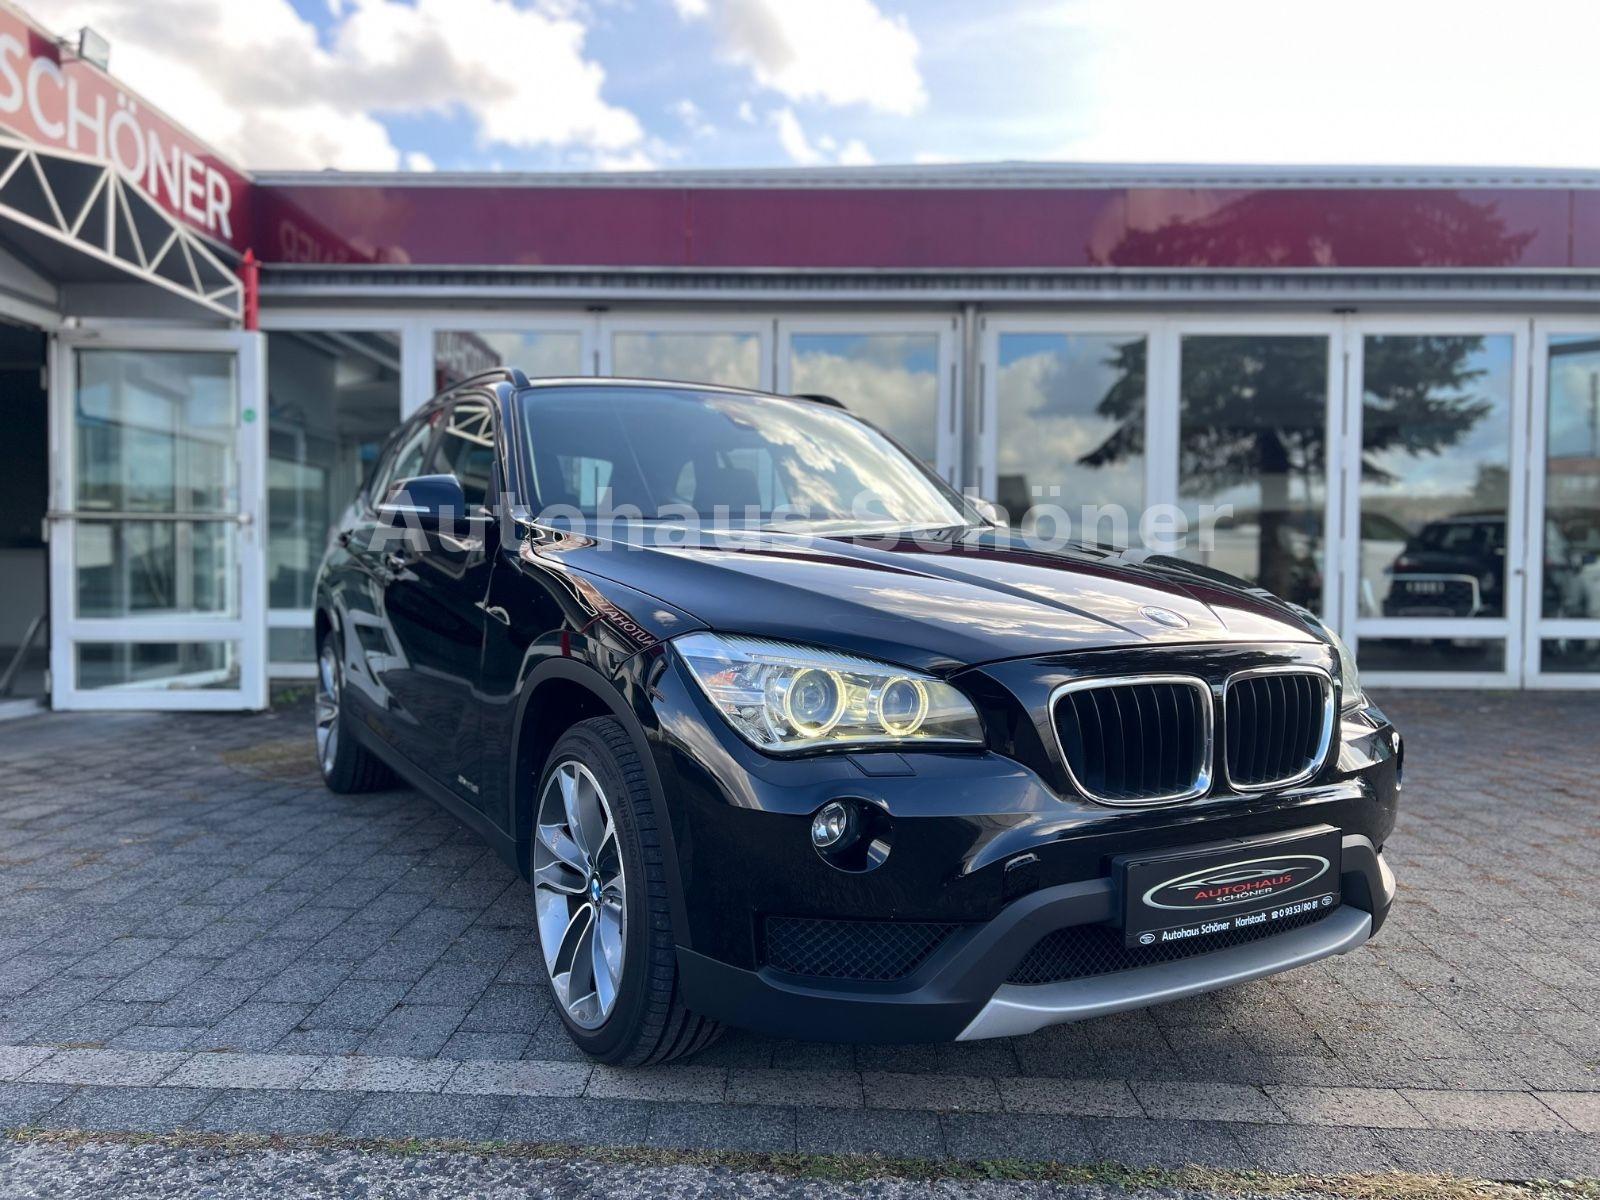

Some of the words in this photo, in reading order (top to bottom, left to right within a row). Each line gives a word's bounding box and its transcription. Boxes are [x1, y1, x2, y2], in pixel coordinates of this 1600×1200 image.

[0, 33, 233, 239] SCHÖNER
[1194, 875, 1292, 899] AUTOHAUS
[1217, 888, 1273, 902] SCHÖNER
[1161, 928, 1199, 942] Autohaus
[1201, 921, 1230, 934] Schöner
[1235, 912, 1267, 928] Karlstadt
